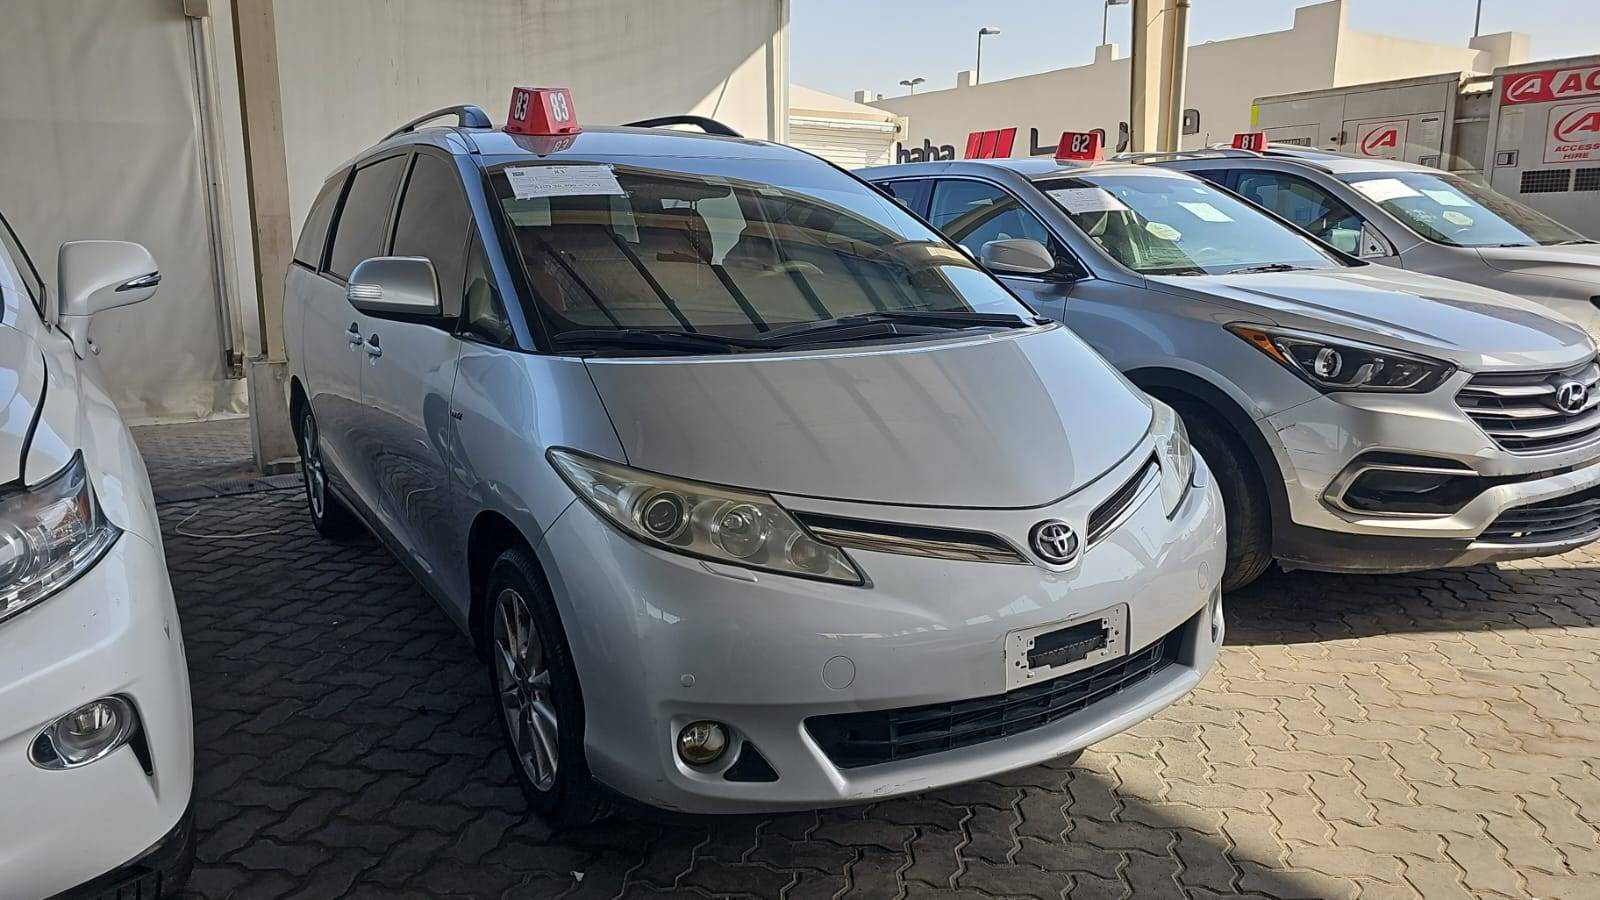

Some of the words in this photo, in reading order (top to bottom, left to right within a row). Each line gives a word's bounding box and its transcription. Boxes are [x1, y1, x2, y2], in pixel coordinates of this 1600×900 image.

[514, 91, 529, 120] 83
[550, 92, 569, 121] 83
[1071, 134, 1091, 153] 82
[1241, 135, 1256, 149] 81
[1554, 143, 1600, 152] ACCESS
[1563, 152, 1588, 160] HIRE
